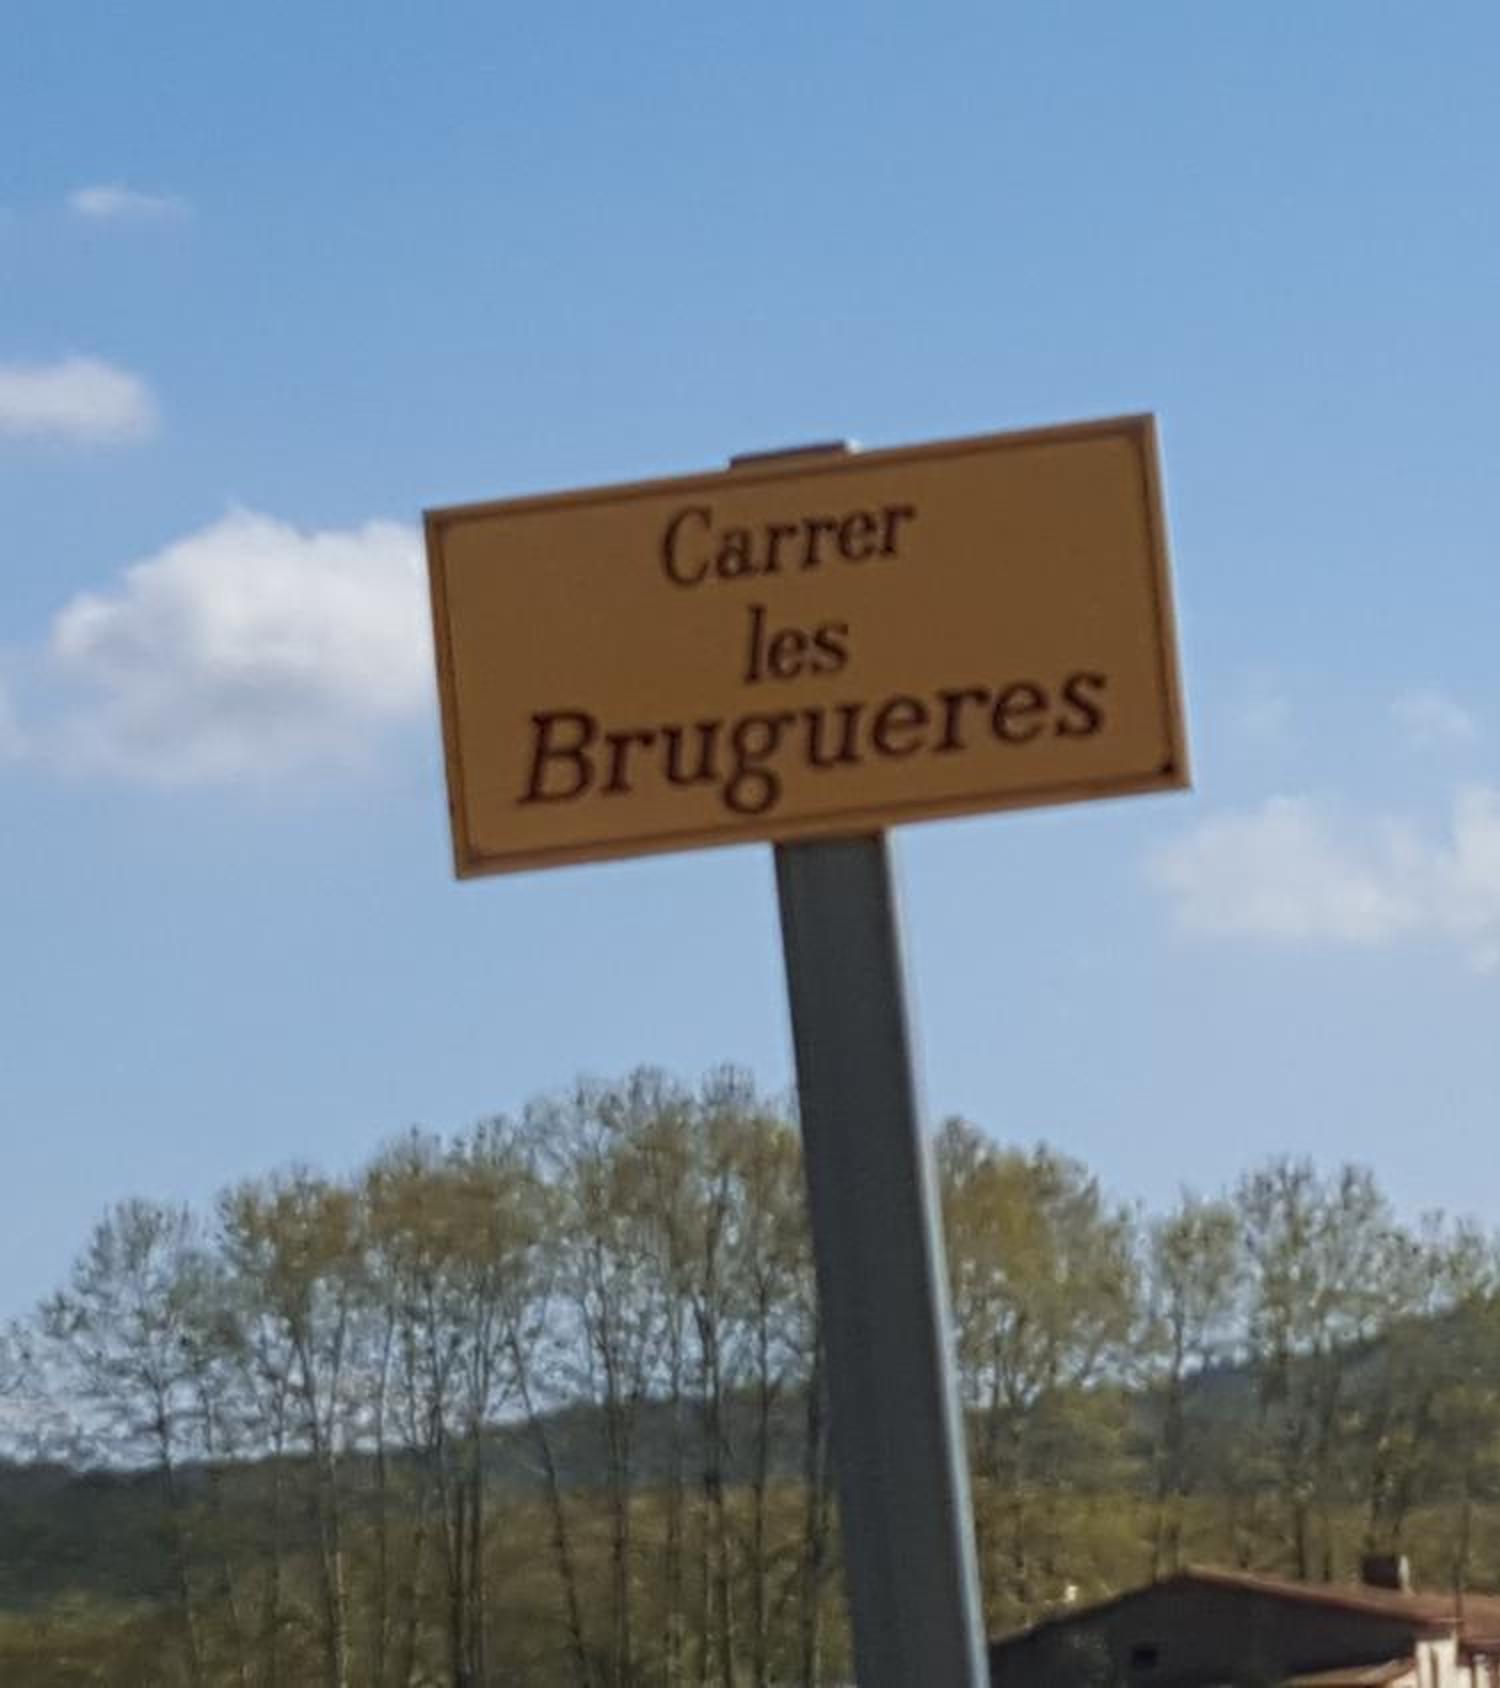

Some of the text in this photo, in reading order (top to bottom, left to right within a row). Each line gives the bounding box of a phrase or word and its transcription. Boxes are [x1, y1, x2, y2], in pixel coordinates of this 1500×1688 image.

[661, 504, 916, 587] Carrer
[742, 605, 849, 683] les
[517, 667, 1108, 815] Brugueres
